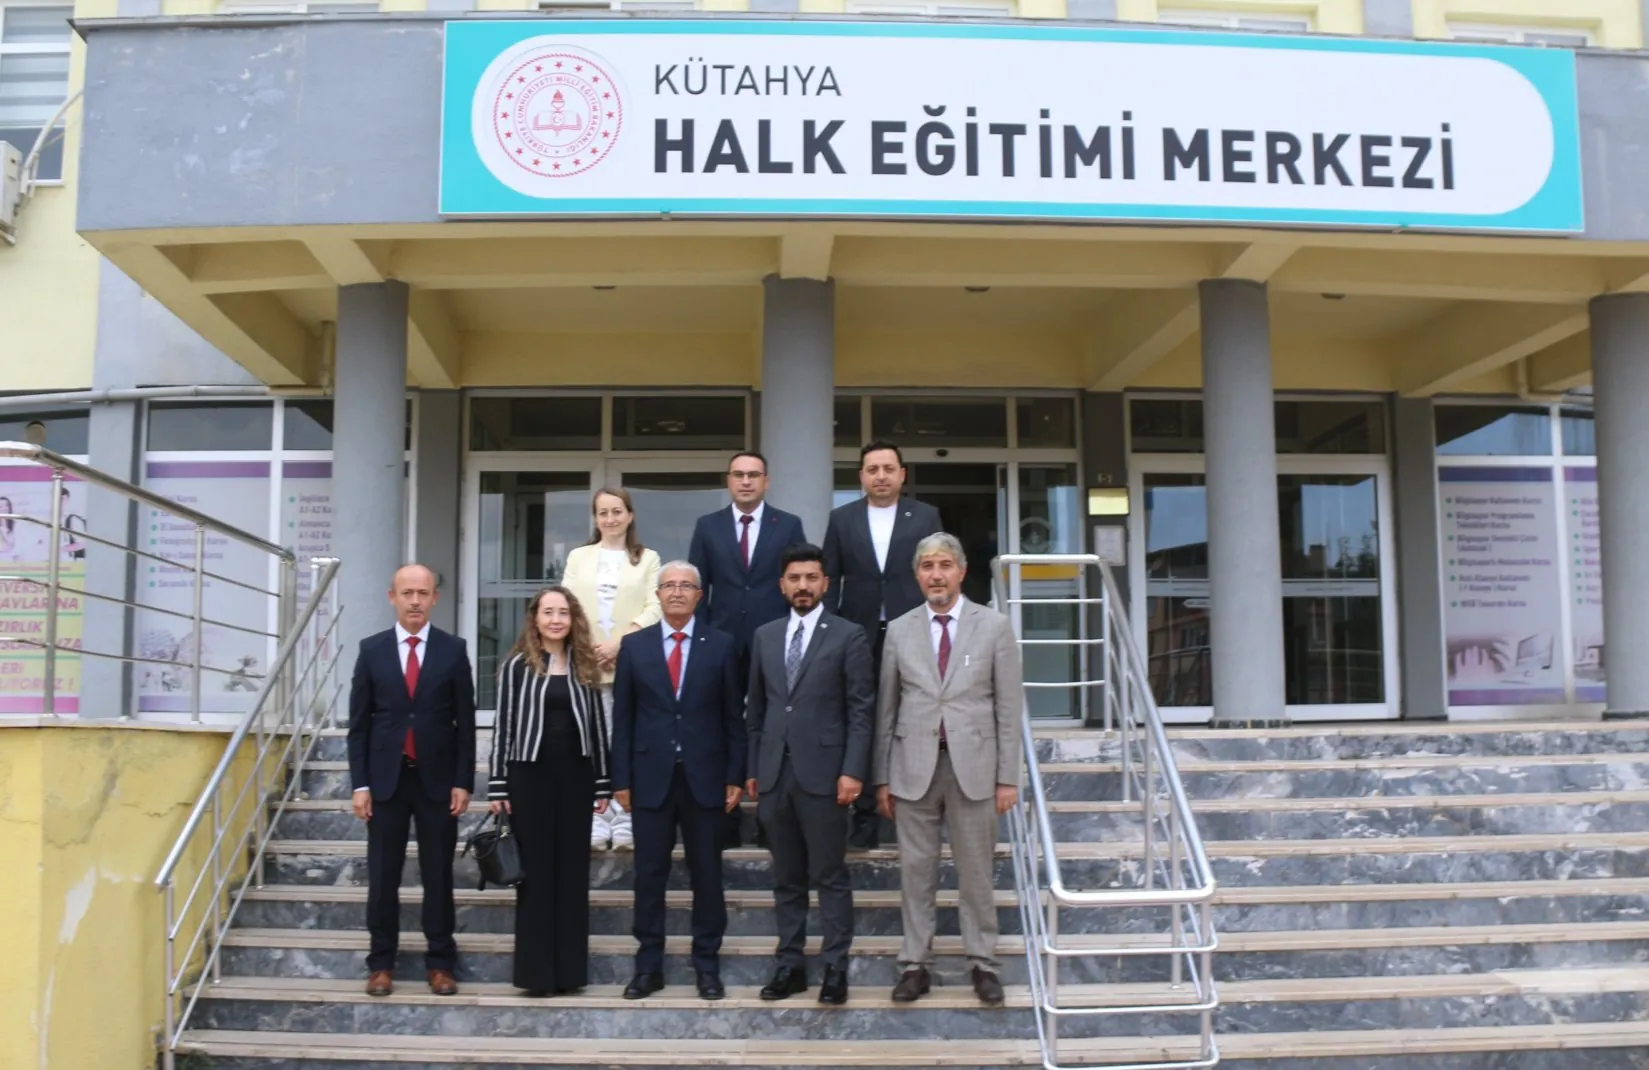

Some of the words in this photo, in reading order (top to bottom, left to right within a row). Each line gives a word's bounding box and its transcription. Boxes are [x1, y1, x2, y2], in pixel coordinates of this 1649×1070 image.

[654, 57, 842, 96] KÜTAHYA
[654, 118, 847, 174] HALK
[871, 104, 1135, 180] EĞİTİMİ
[1162, 122, 1455, 190] MERKEZİ
